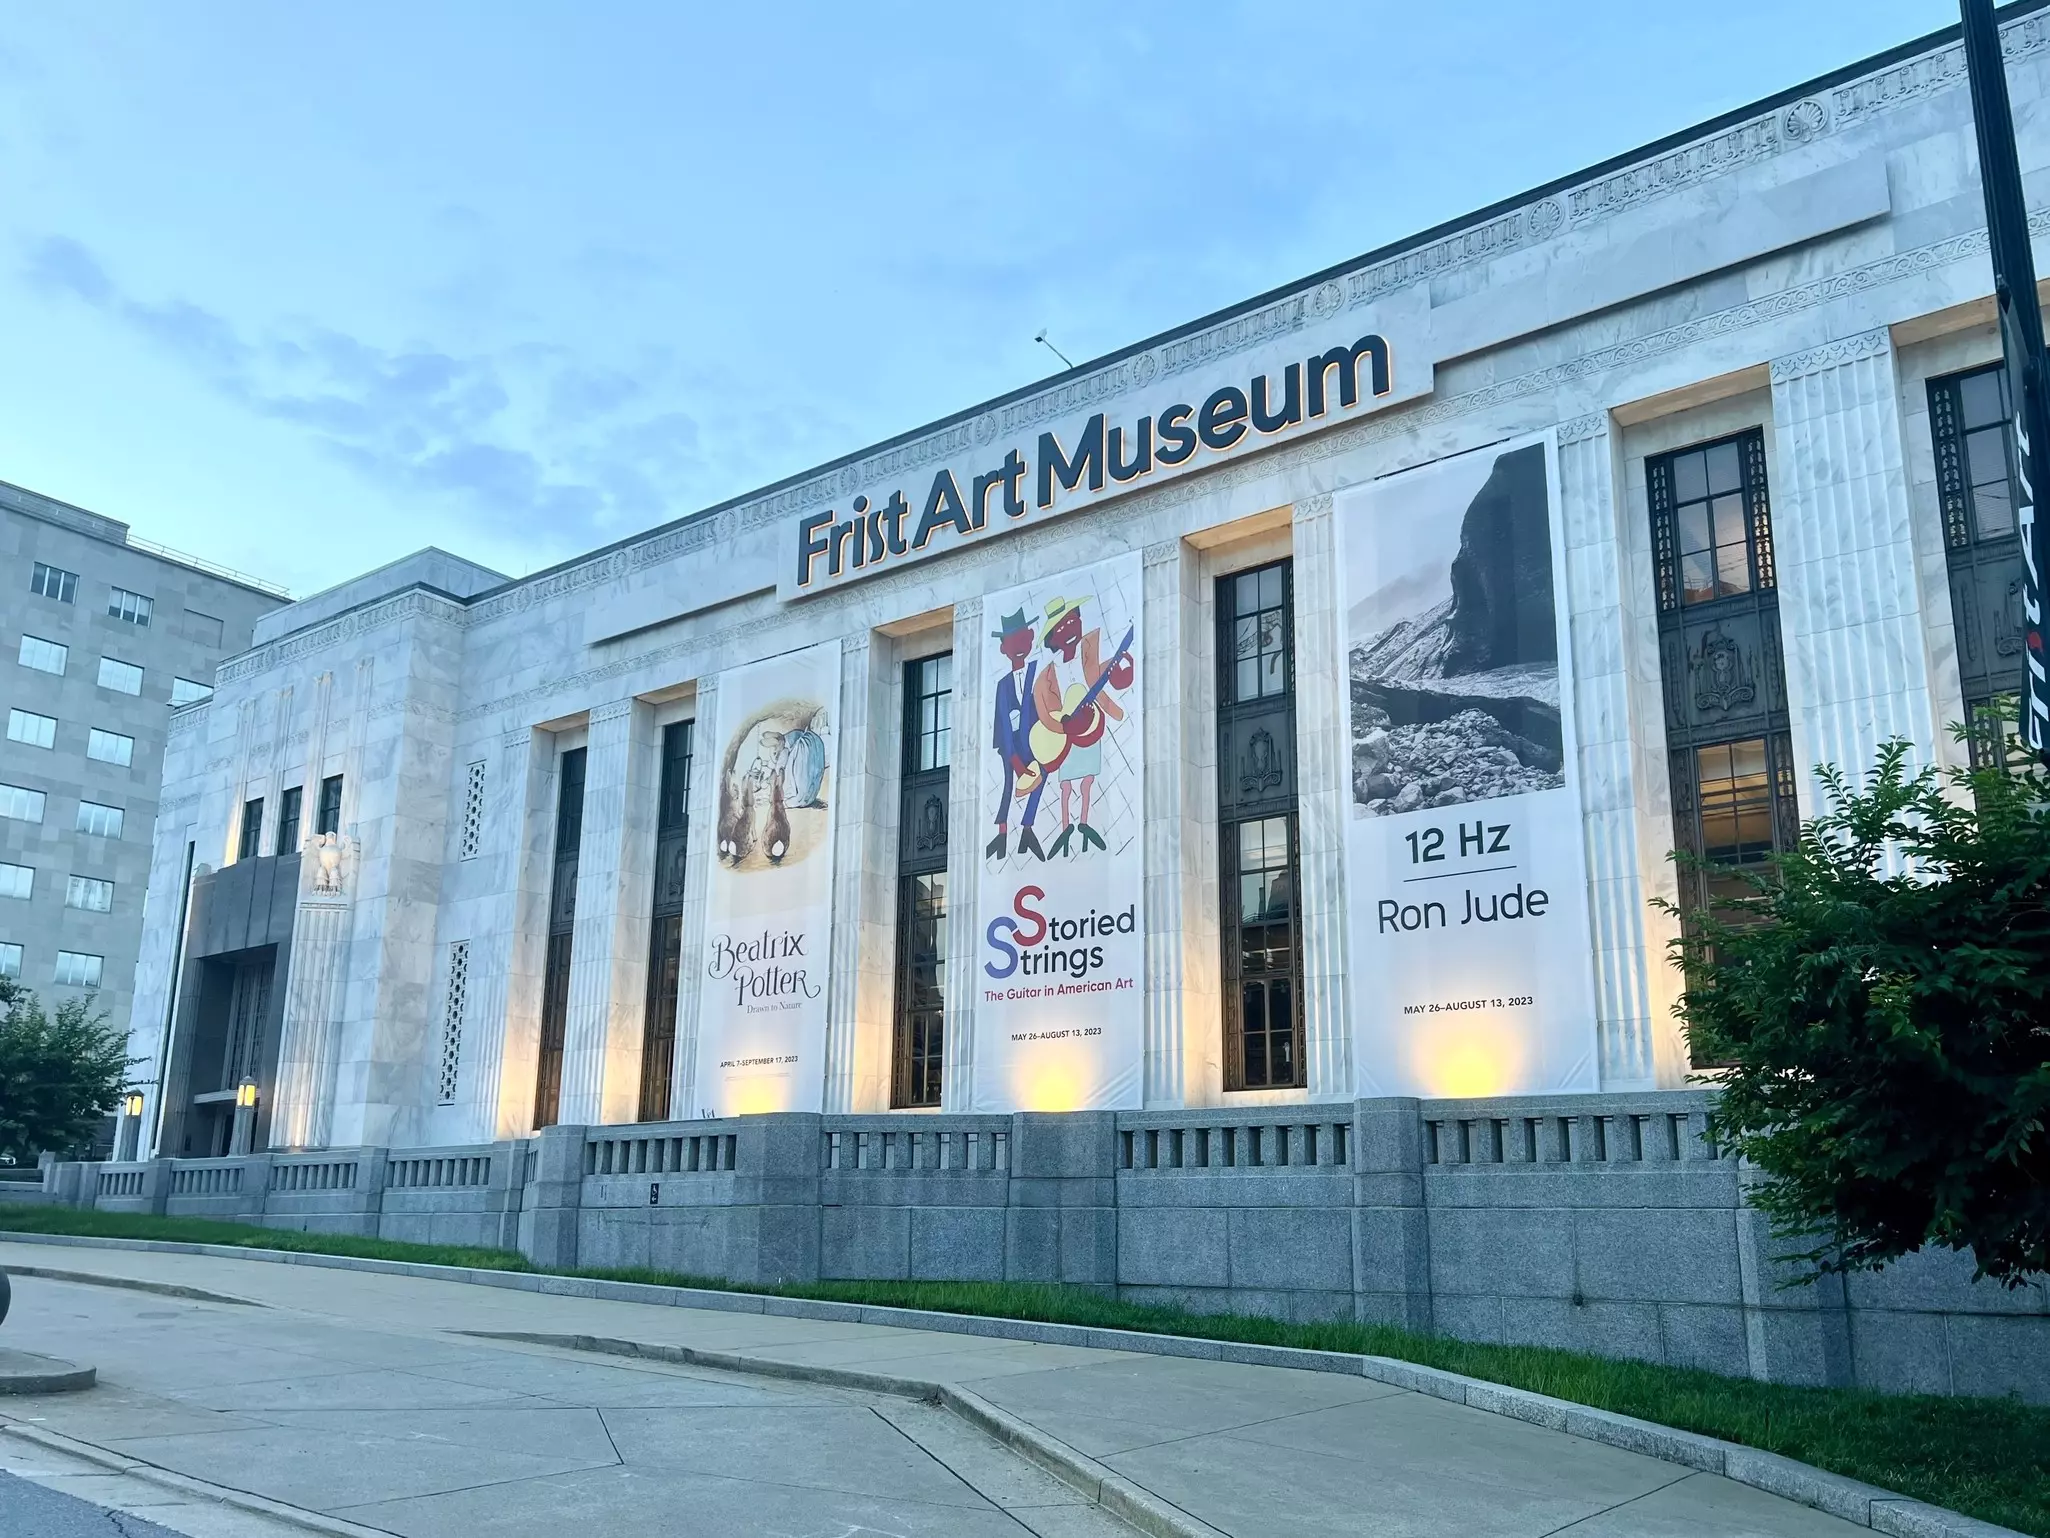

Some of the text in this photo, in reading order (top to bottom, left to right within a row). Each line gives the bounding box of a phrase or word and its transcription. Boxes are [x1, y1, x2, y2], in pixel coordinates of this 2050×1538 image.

[797, 334, 1391, 587] Frist Art Museum
[1405, 820, 1512, 864] 12 Hz
[1012, 885, 1135, 946] Storied
[1378, 883, 1549, 934] Ron Jude
[708, 929, 808, 979] Beatrix
[984, 916, 1104, 979] Strings
[733, 965, 821, 1006] Potter
[984, 977, 1134, 1002] The Guitar in American Art
[1404, 1004, 1426, 1015] MAY
[1490, 998, 1505, 1009] 13,
[1508, 996, 1534, 1007] 2023
[746, 1001, 803, 1014] Drawn to Nature
[1011, 1033, 1028, 1041] MAY
[1072, 1029, 1082, 1037] 13,
[1084, 1027, 1102, 1036] 2023
[720, 1060, 735, 1068] APRIL
[775, 1056, 783, 1064] 17,
[784, 1055, 799, 1063] 2023
